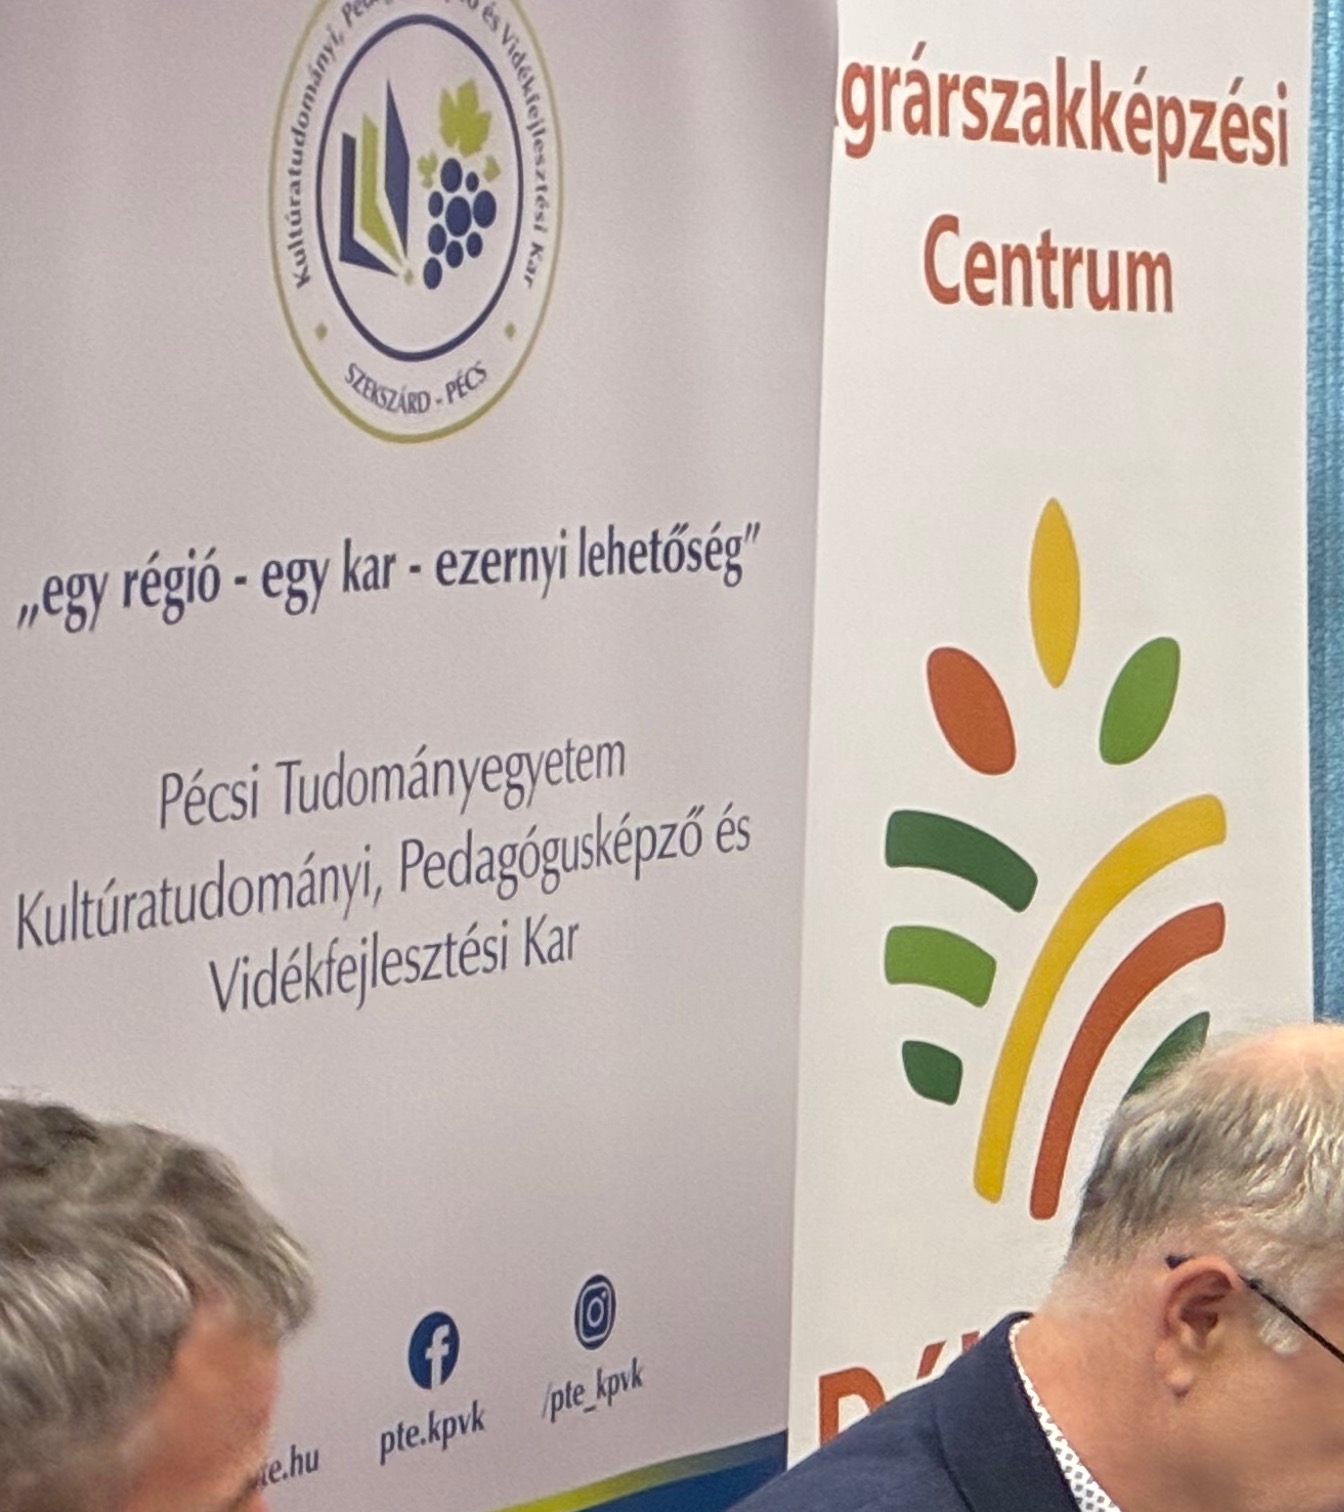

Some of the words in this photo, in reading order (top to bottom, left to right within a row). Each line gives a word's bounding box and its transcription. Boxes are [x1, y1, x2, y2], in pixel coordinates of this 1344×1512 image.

[502, 22, 551, 234] Vidékfejlesztési
[841, 40, 1289, 185] grárszakképzési
[523, 241, 545, 289] Kar
[923, 213, 1174, 314] Centrum
[344, 361, 432, 415] SZEKSZÁRD
[445, 360, 488, 405] PÉCS
[123, 546, 222, 626] régió
[233, 575, 249, 587] -
[261, 556, 330, 616] egy
[342, 537, 397, 594] kar
[407, 563, 423, 574] -
[435, 528, 568, 600] ezernyi
[160, 763, 260, 831] Pécsi
[276, 738, 627, 815] Tudományegyetem
[16, 844, 383, 952] Kultúratudományi,
[400, 803, 705, 901] Pedagógusképző
[715, 801, 752, 855] és
[207, 918, 510, 1014] Vidékfejlesztési
[524, 913, 581, 969] Kar
[379, 1399, 486, 1467] pte.kpvk
[542, 1356, 645, 1424] /pte_kpvk
